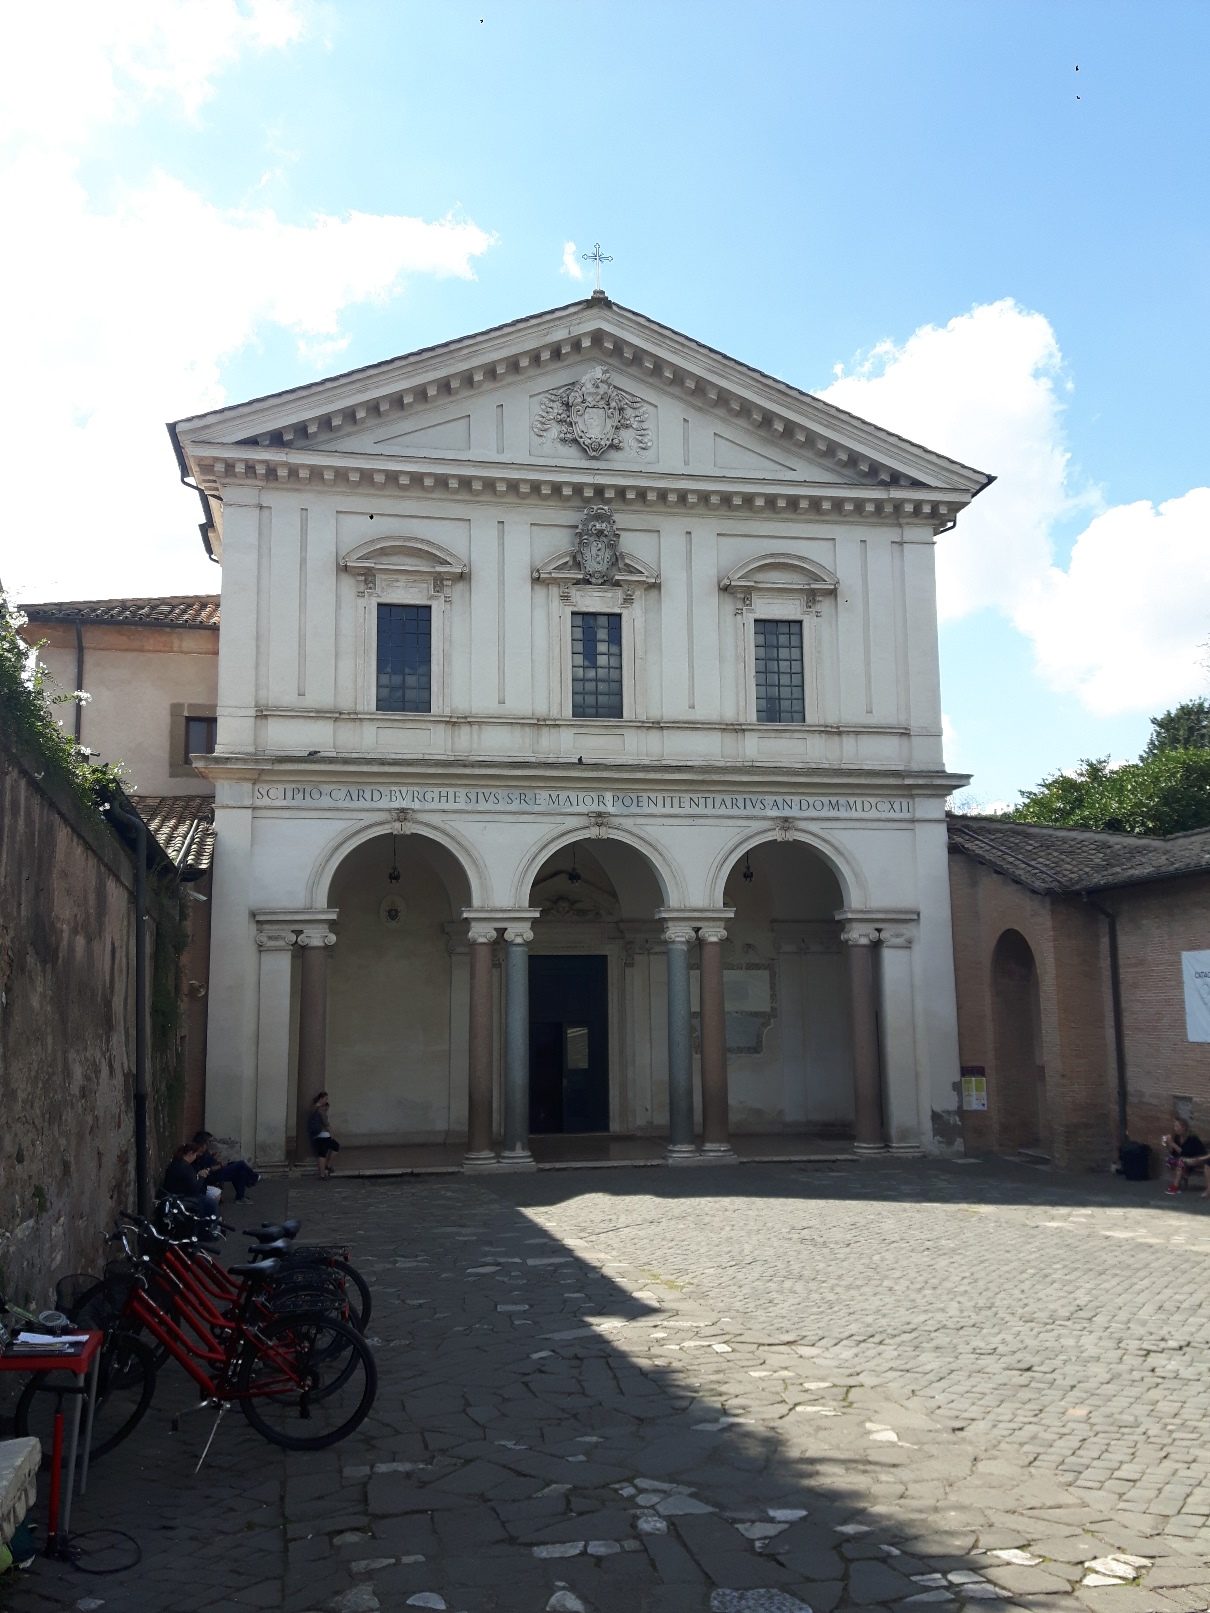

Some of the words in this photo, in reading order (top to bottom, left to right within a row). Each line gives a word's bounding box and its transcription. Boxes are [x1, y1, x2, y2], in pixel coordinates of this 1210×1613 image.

[256, 787, 322, 800] SCIPIO
[329, 788, 383, 802] CARD
[389, 789, 500, 805] BVRGHESIVS
[547, 794, 607, 807] MAIOR
[612, 795, 766, 811] POENITENTIARIVS
[769, 798, 793, 811] AN
[799, 799, 840, 812] DOM
[845, 800, 911, 813] MDCXII
